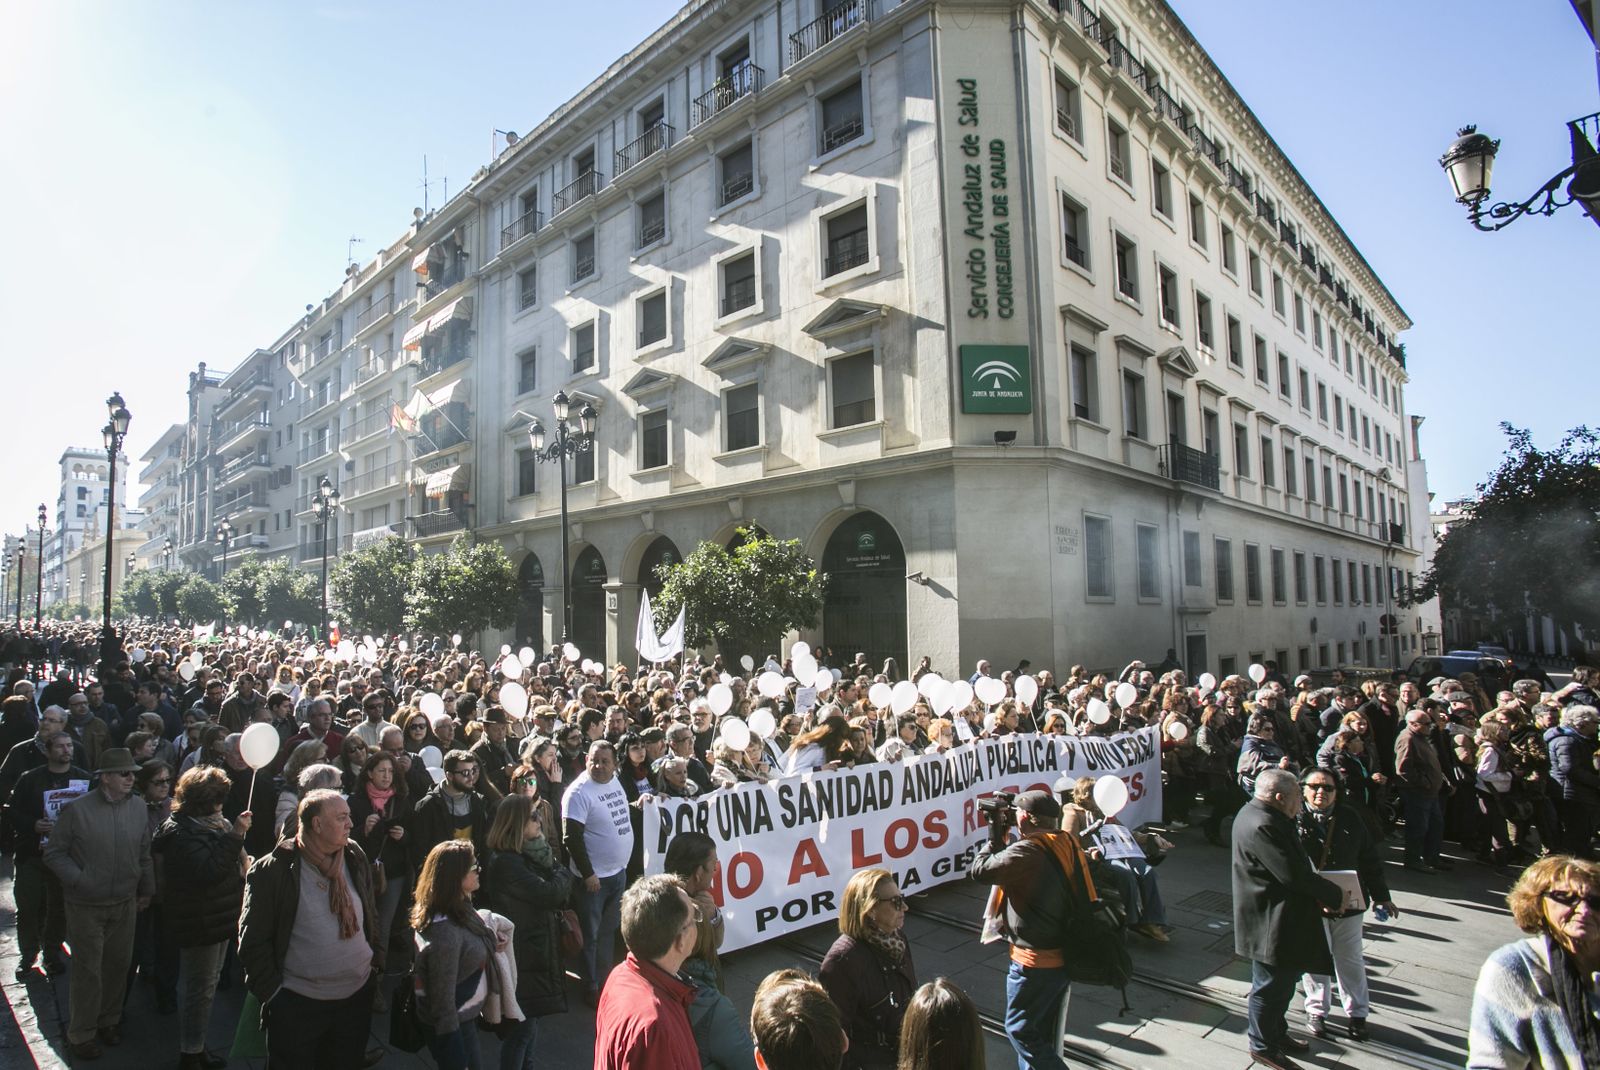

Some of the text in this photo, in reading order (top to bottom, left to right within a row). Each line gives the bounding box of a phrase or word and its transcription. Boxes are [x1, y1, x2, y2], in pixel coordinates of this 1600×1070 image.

[956, 79, 989, 319] Servicio Andaluz de Salud
[989, 139, 1014, 319] CONSEJERÍA DE SALUD
[716, 789, 774, 841] UNA
[778, 769, 894, 829] SANIDAD
[901, 747, 984, 806] ANDALUZA
[986, 739, 1058, 780] PUBLICA
[1063, 740, 1076, 771] Y
[787, 837, 831, 886] A
[851, 809, 949, 870] LOS
[755, 890, 837, 933] POR
